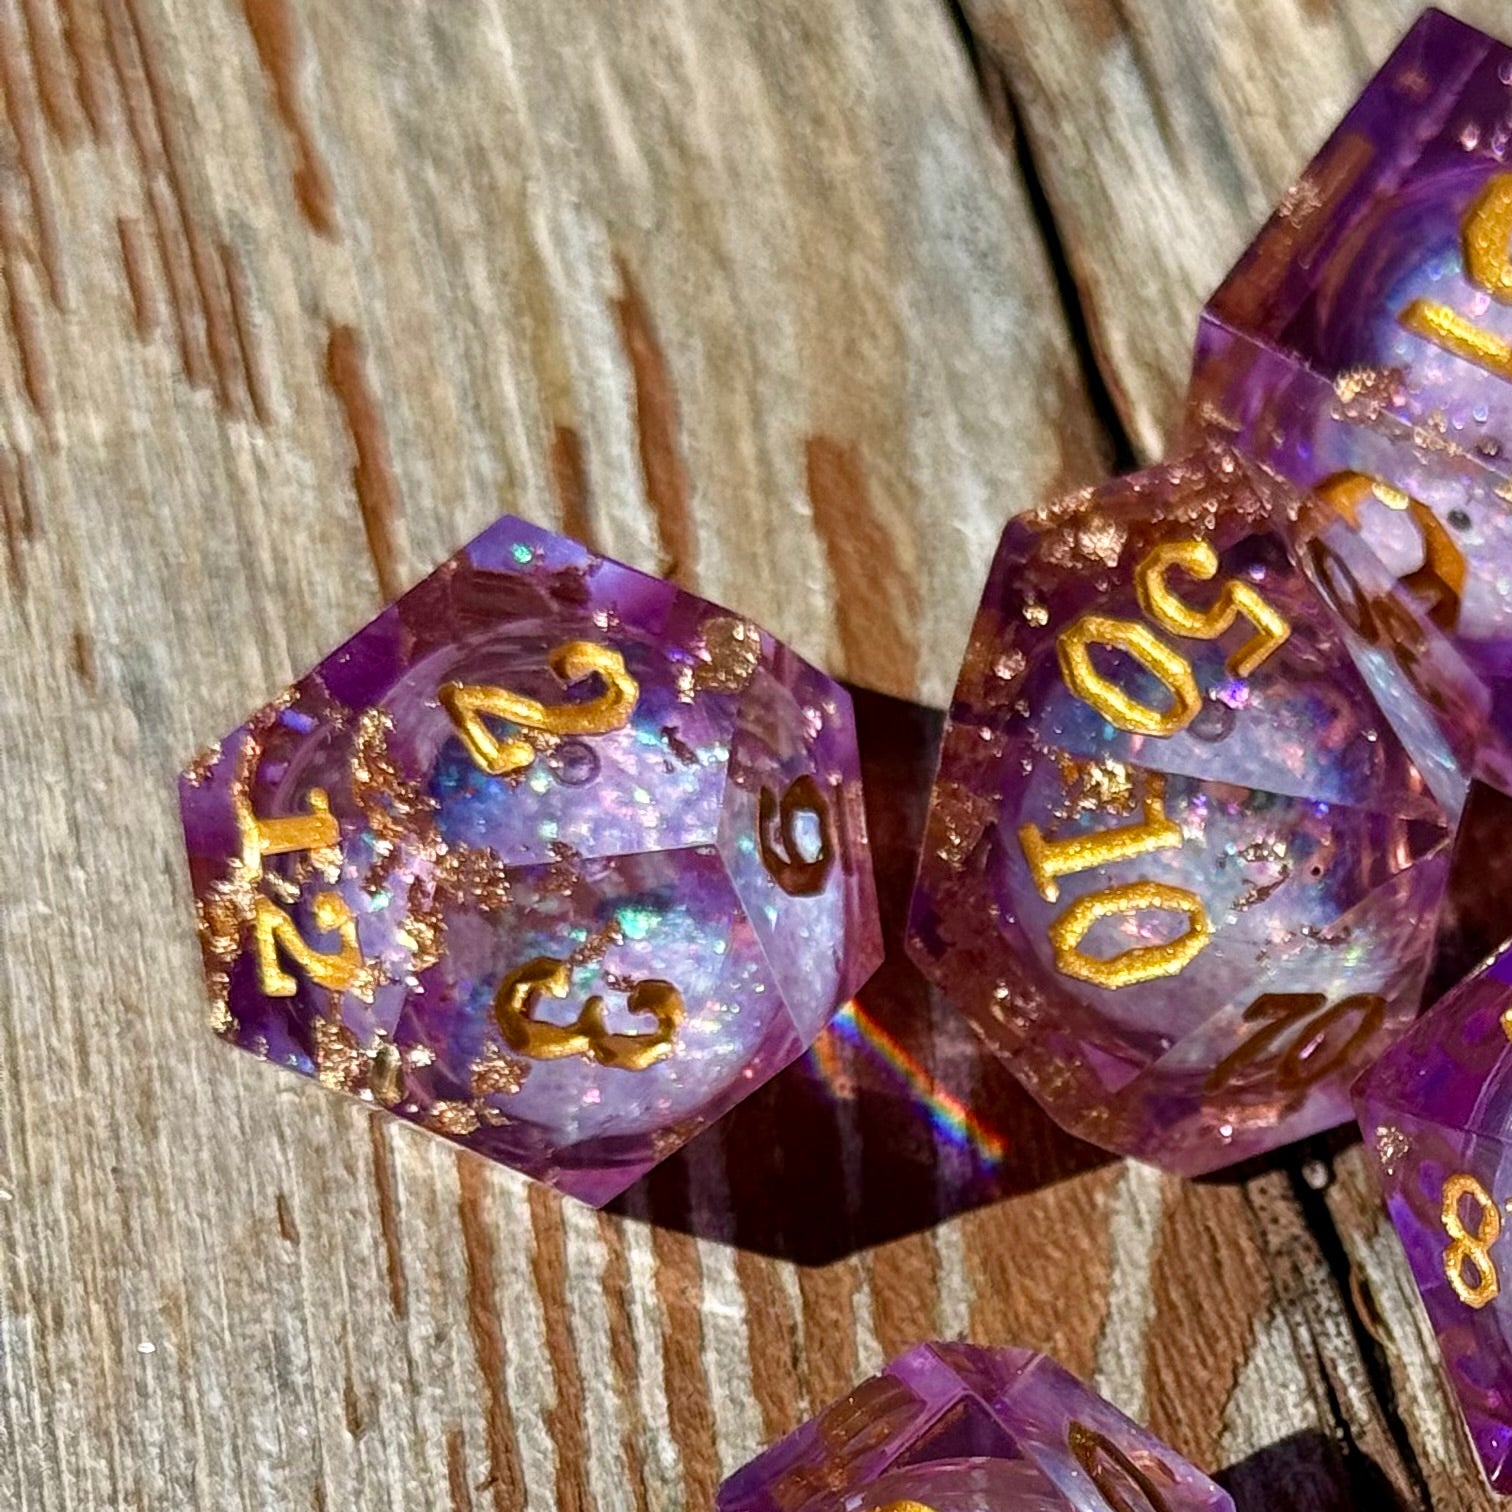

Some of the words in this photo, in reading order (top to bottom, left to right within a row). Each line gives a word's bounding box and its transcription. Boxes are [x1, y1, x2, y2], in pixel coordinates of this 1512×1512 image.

[439, 641, 640, 775] 2
[1056, 540, 1291, 737] 50
[1018, 772, 1213, 990] 10
[497, 956, 686, 1072] 3
